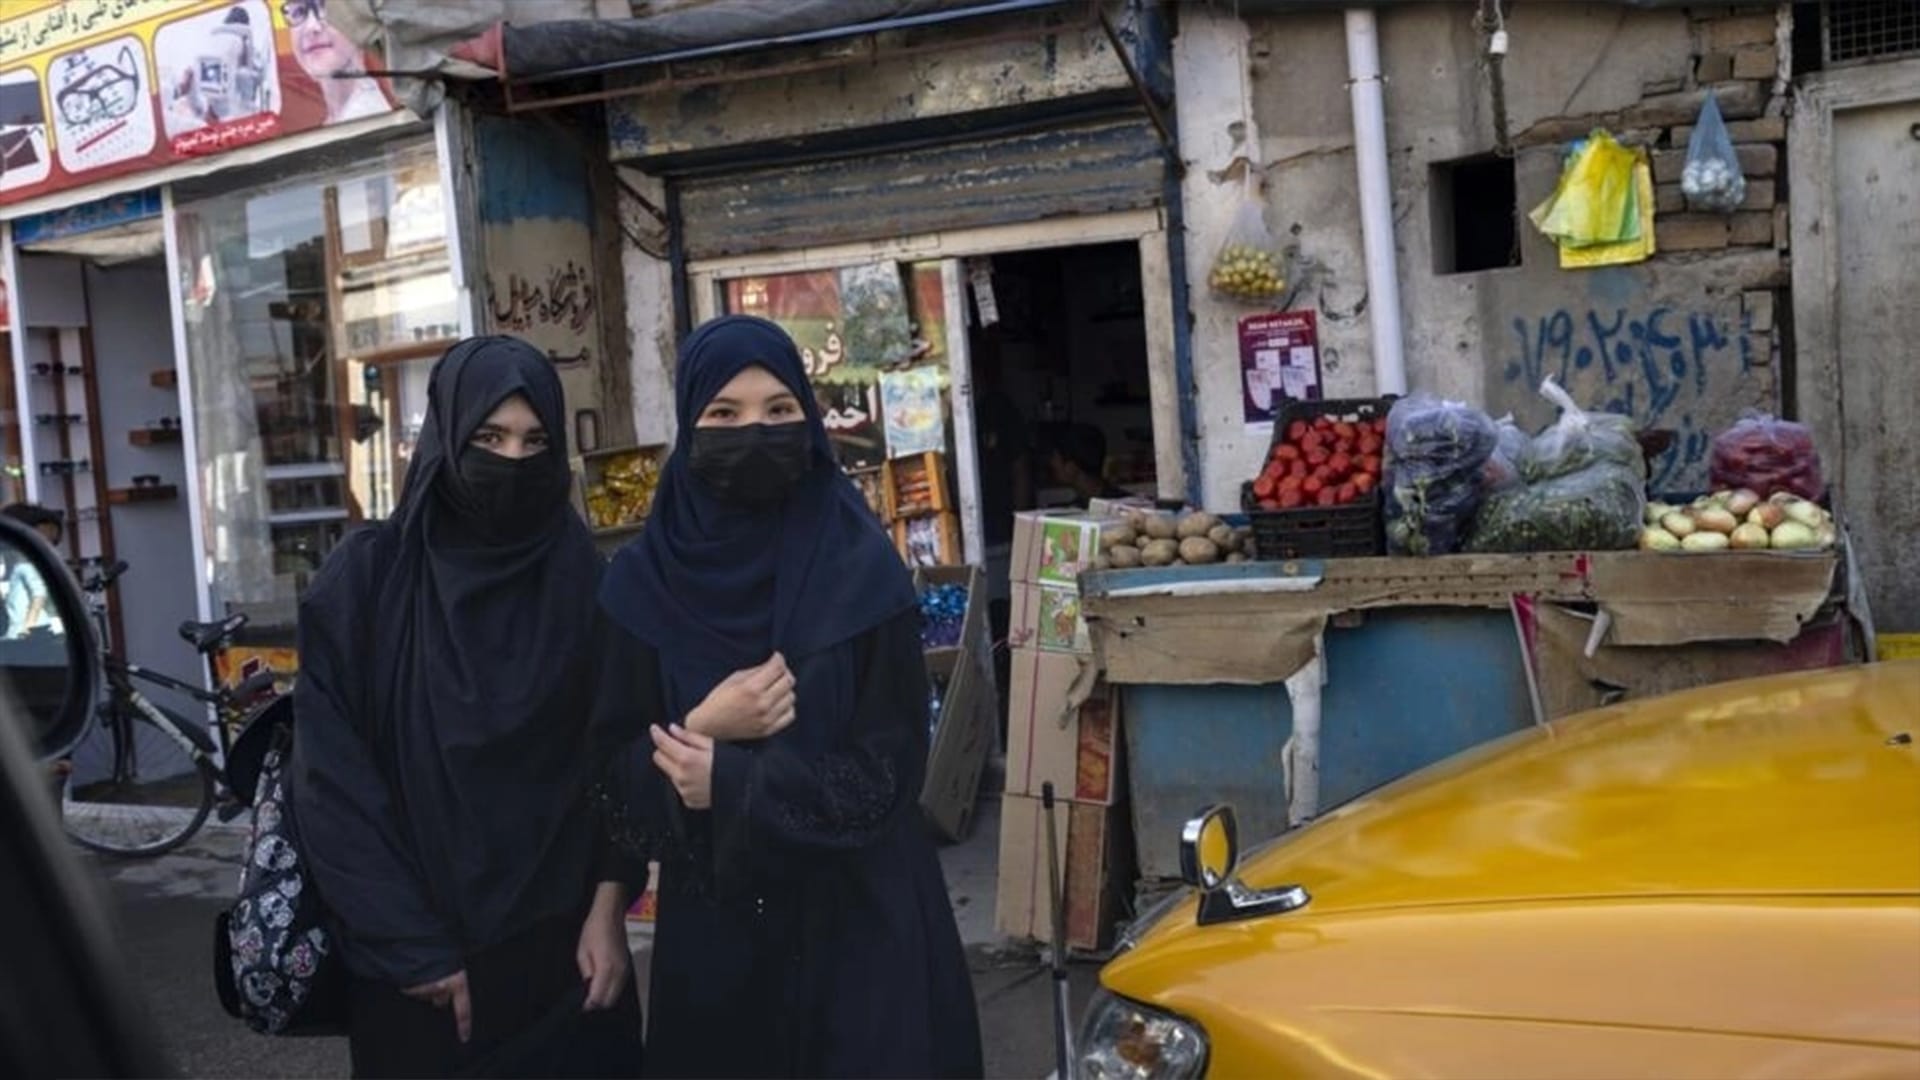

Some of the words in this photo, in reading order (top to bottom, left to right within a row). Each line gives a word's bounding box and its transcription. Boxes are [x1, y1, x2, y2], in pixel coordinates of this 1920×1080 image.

[71, 12, 79, 33] و
[802, 320, 842, 374] فرو
[823, 384, 878, 429] احم
